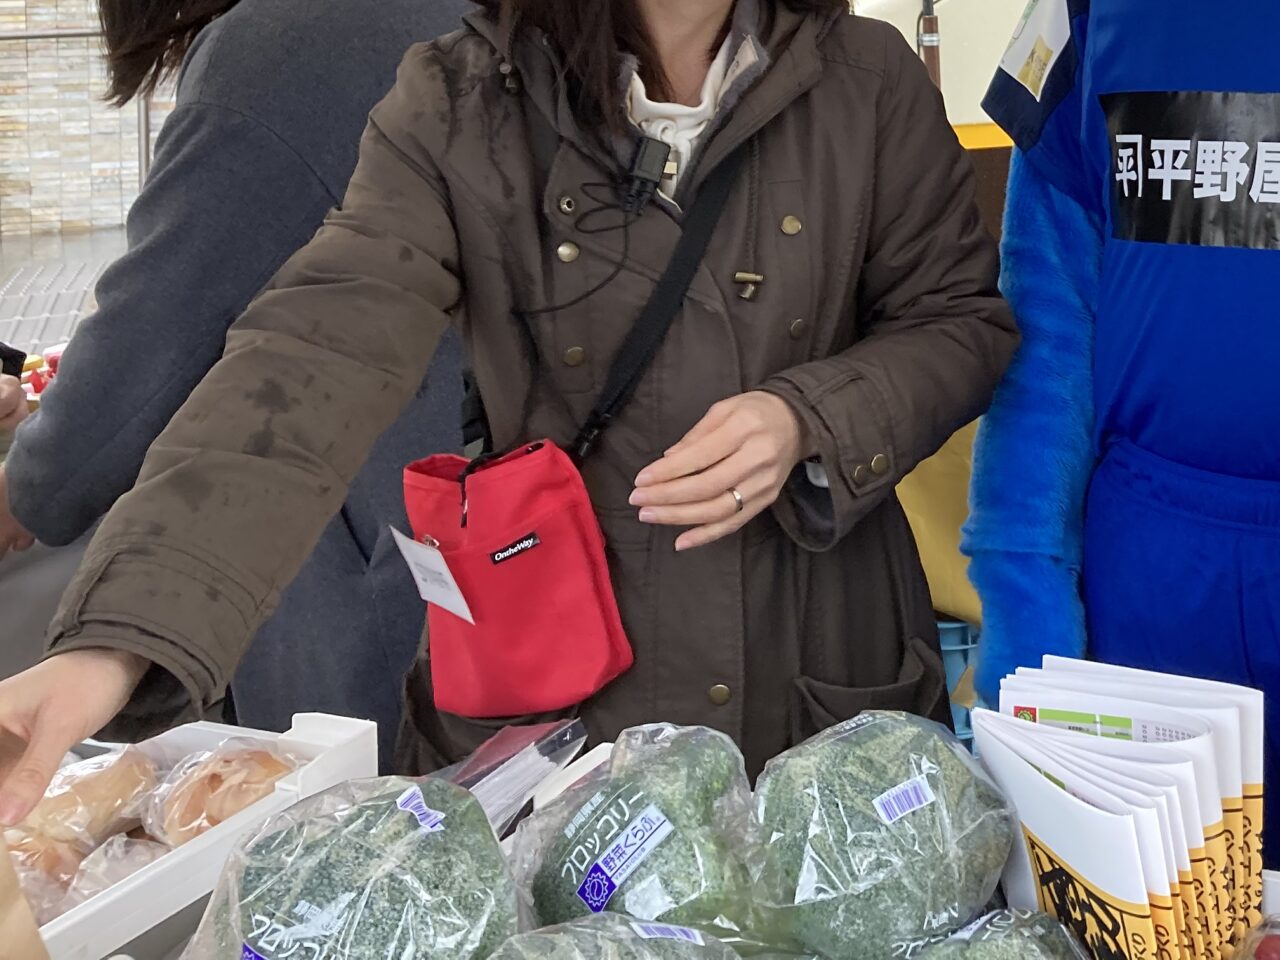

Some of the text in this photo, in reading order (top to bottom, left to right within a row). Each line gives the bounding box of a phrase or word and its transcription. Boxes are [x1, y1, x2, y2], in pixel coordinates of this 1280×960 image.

[561, 791, 644, 885] ブロッコリー
[601, 816, 656, 873] 野菜くらぶ
